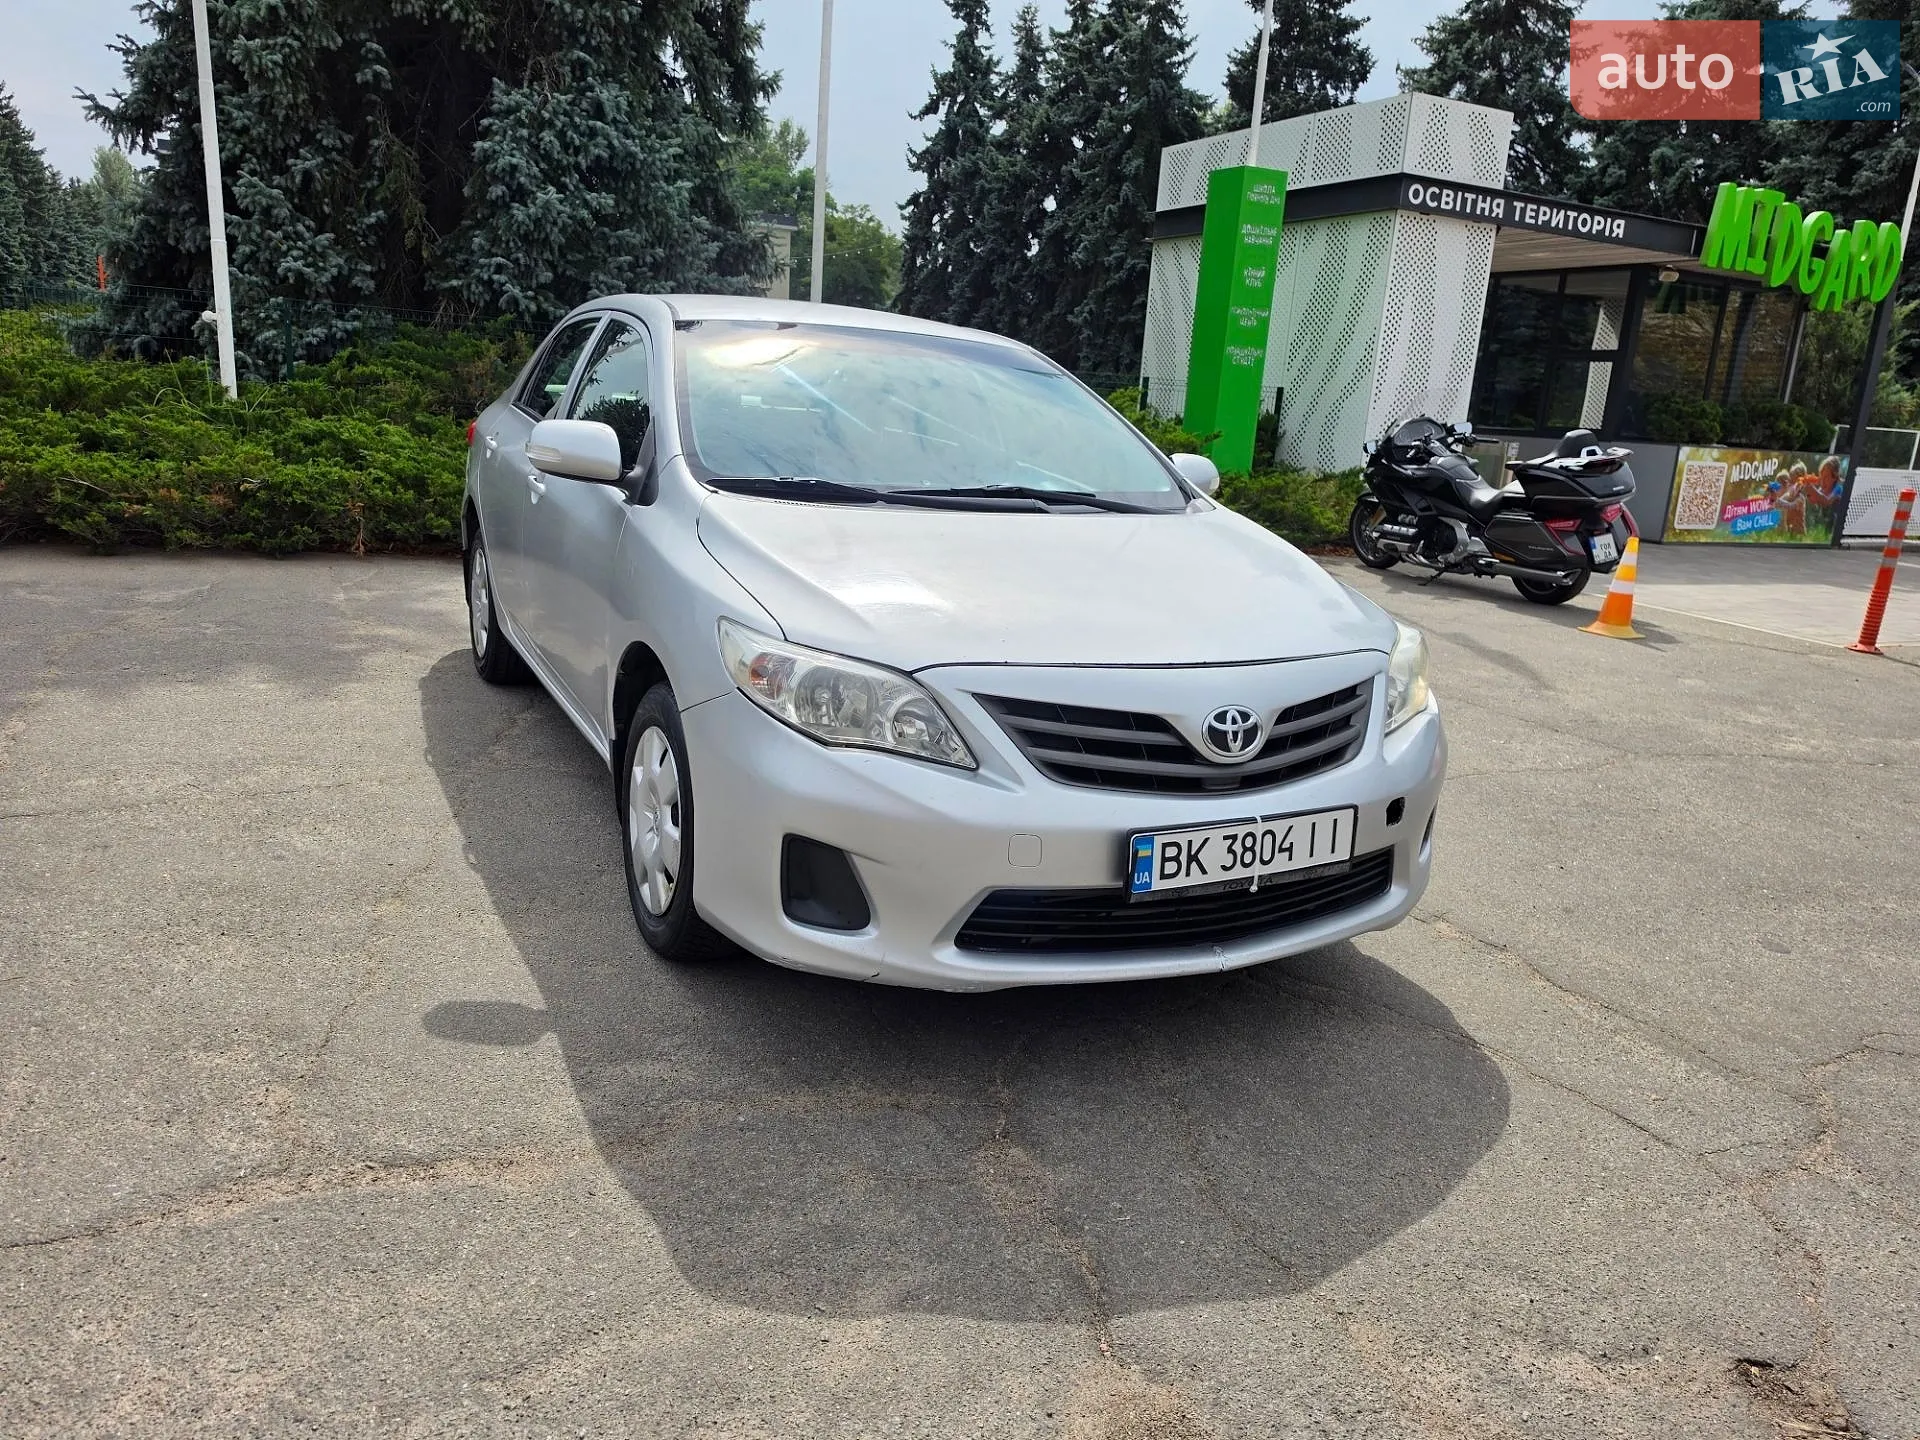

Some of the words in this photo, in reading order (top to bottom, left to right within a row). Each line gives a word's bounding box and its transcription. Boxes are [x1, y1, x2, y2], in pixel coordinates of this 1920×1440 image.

[1407, 183, 1505, 219] ОСВІТНЯ
[1513, 201, 1626, 239] ТЕРИТОРІЯ
[1700, 182, 1903, 312] MIDGARD
[1730, 458, 1779, 483] MIDCAMP
[1753, 513, 1774, 528] CHILL
[1159, 837, 1210, 880] BK
[1220, 825, 1294, 871] 3804
[1134, 871, 1151, 885] UA
